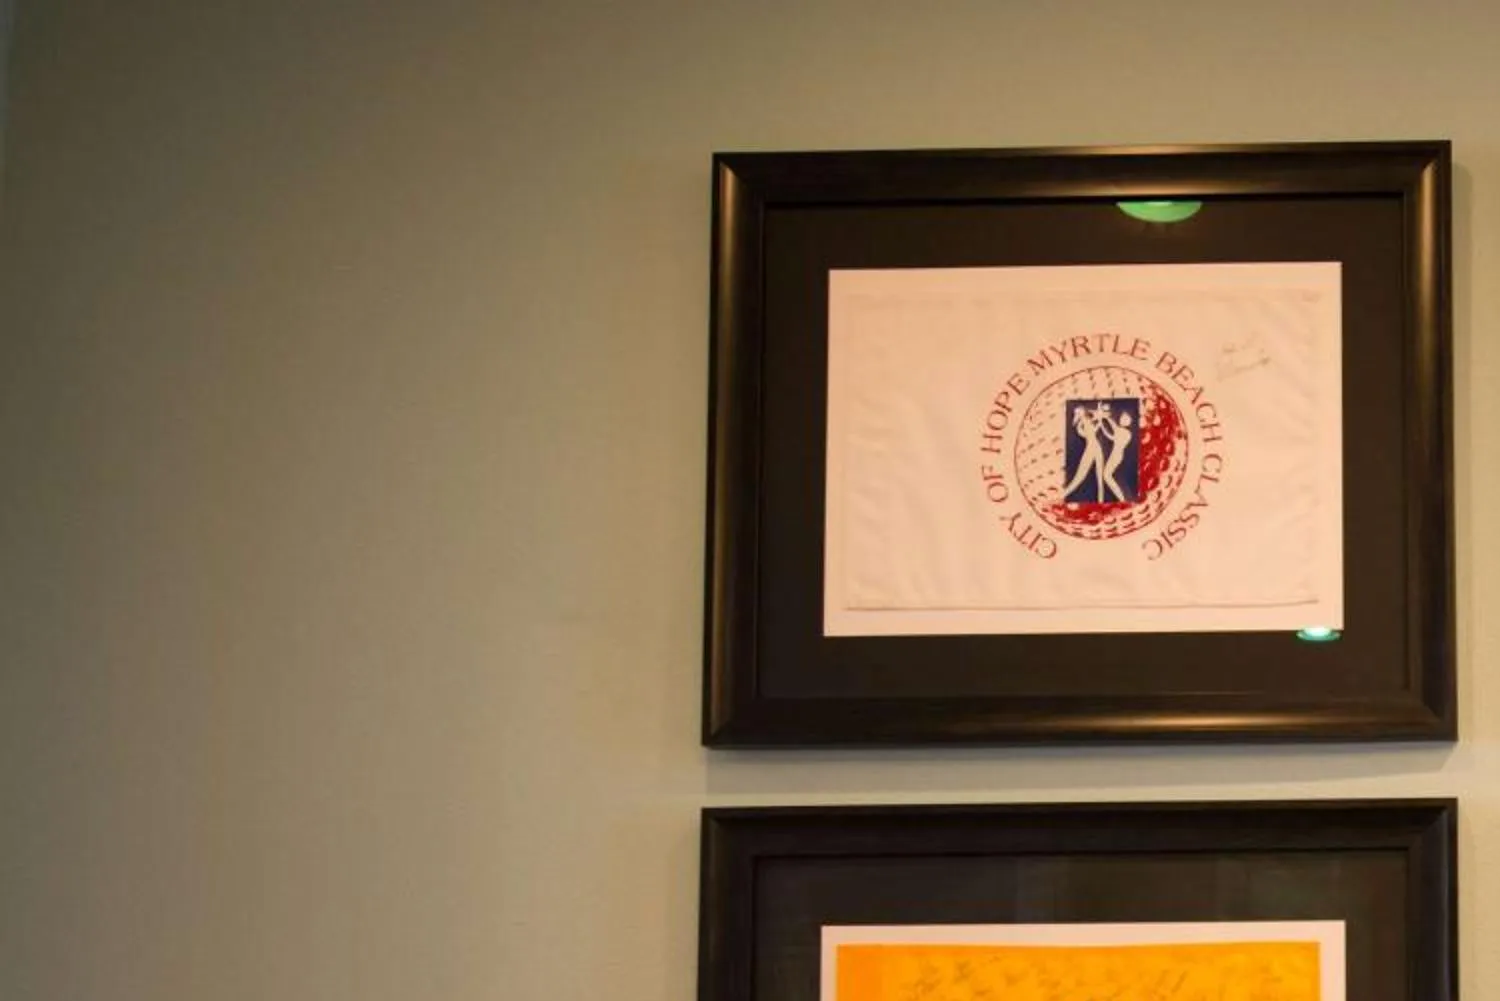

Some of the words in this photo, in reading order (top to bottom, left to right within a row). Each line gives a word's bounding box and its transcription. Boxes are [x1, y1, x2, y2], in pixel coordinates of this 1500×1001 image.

[1027, 333, 1152, 377] MYRTLE
[980, 372, 1031, 454] HOPE
[1155, 351, 1223, 443] BEACH
[981, 464, 1009, 503] OF
[1141, 453, 1223, 561] CLASSIC
[999, 511, 1058, 560] CITY
